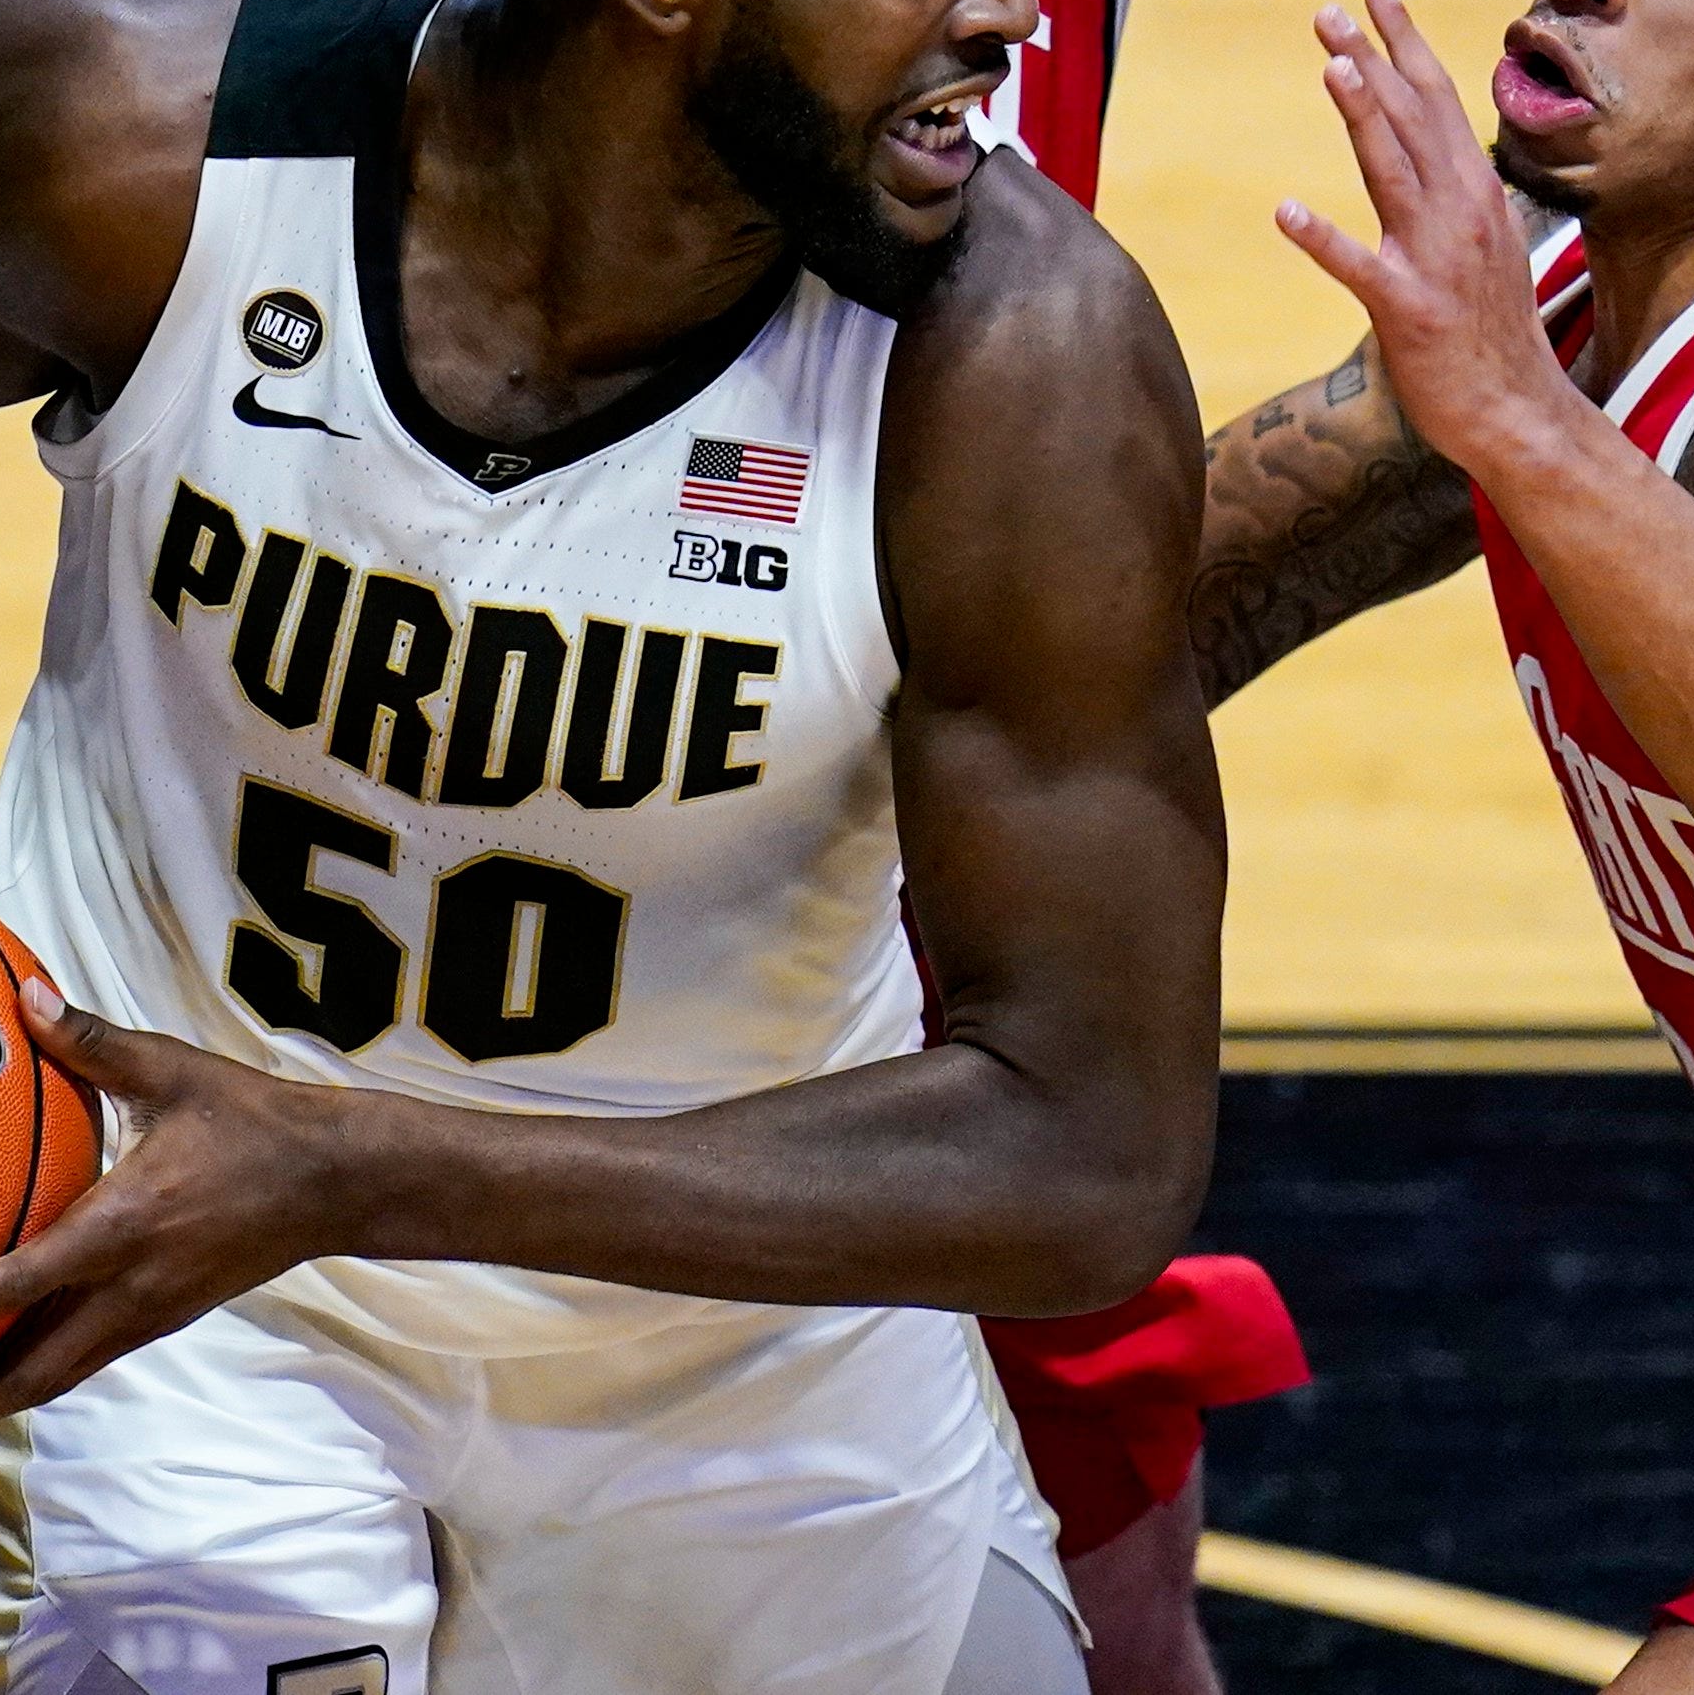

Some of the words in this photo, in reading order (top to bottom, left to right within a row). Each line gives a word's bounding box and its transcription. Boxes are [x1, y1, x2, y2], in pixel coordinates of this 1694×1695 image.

[256, 306, 311, 351] MJB
[149, 475, 785, 810] PURDUE
[221, 772, 633, 1065] 50
